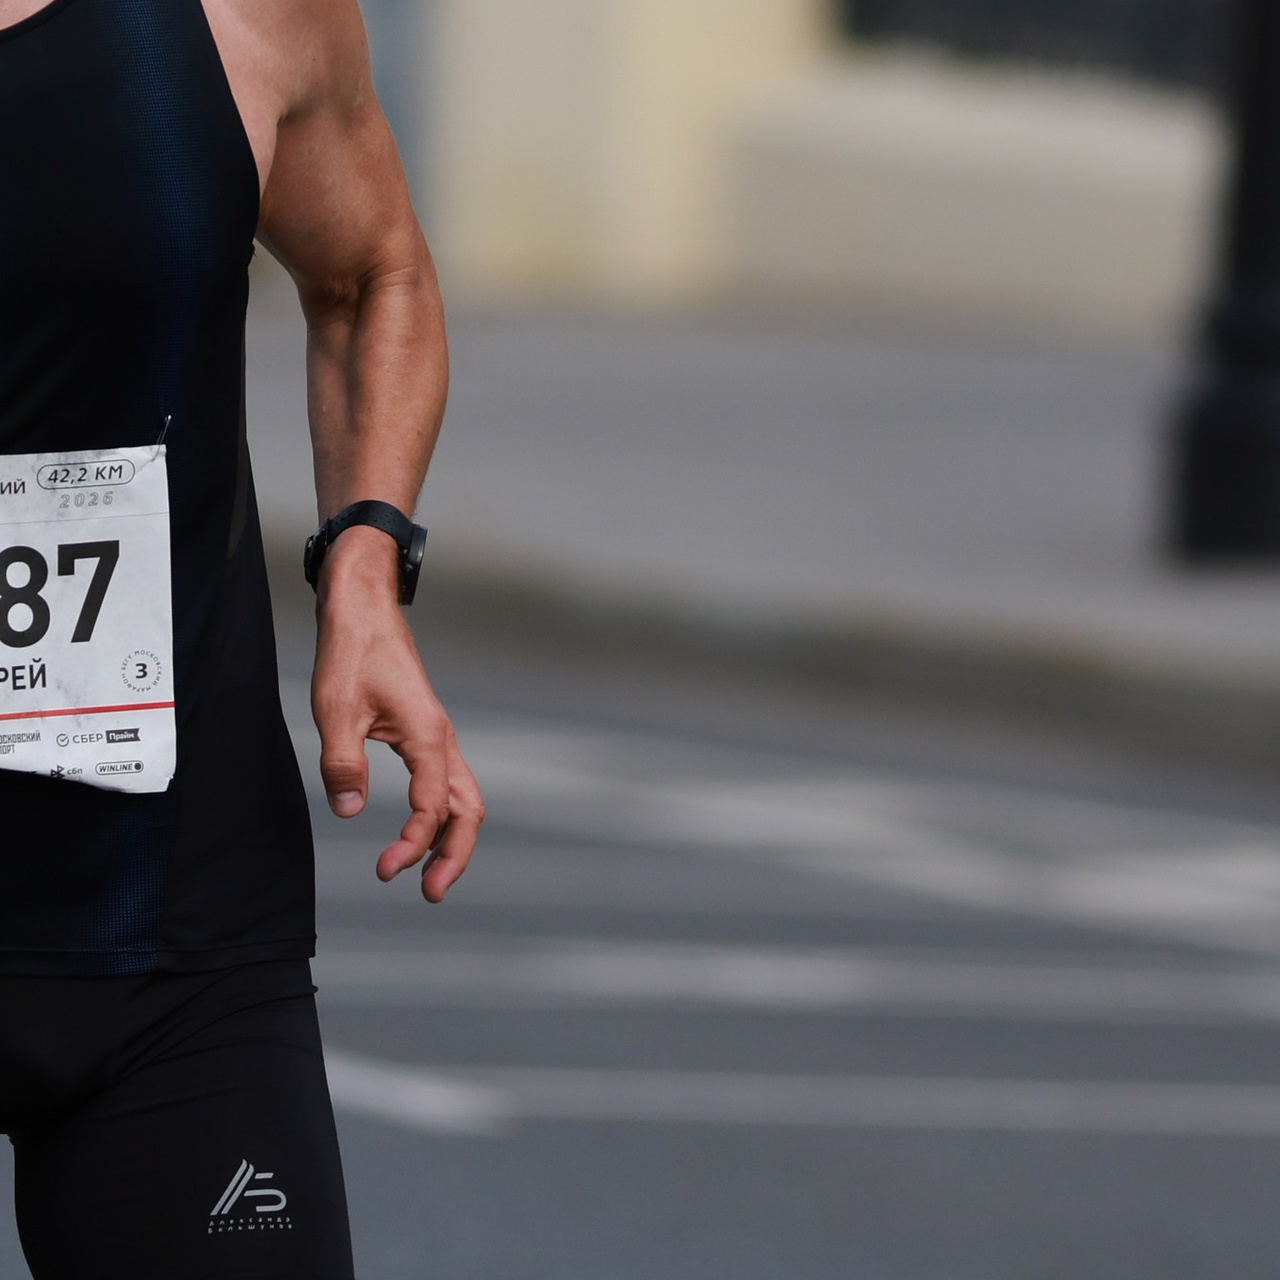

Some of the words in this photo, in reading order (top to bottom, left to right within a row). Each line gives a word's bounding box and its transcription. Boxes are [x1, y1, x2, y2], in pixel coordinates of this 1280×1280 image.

[47, 468, 88, 485] 42,2
[59, 491, 114, 509] 2026
[135, 662, 148, 679] 3
[73, 733, 103, 744] СБЕР
[99, 763, 133, 773] WINLINE
